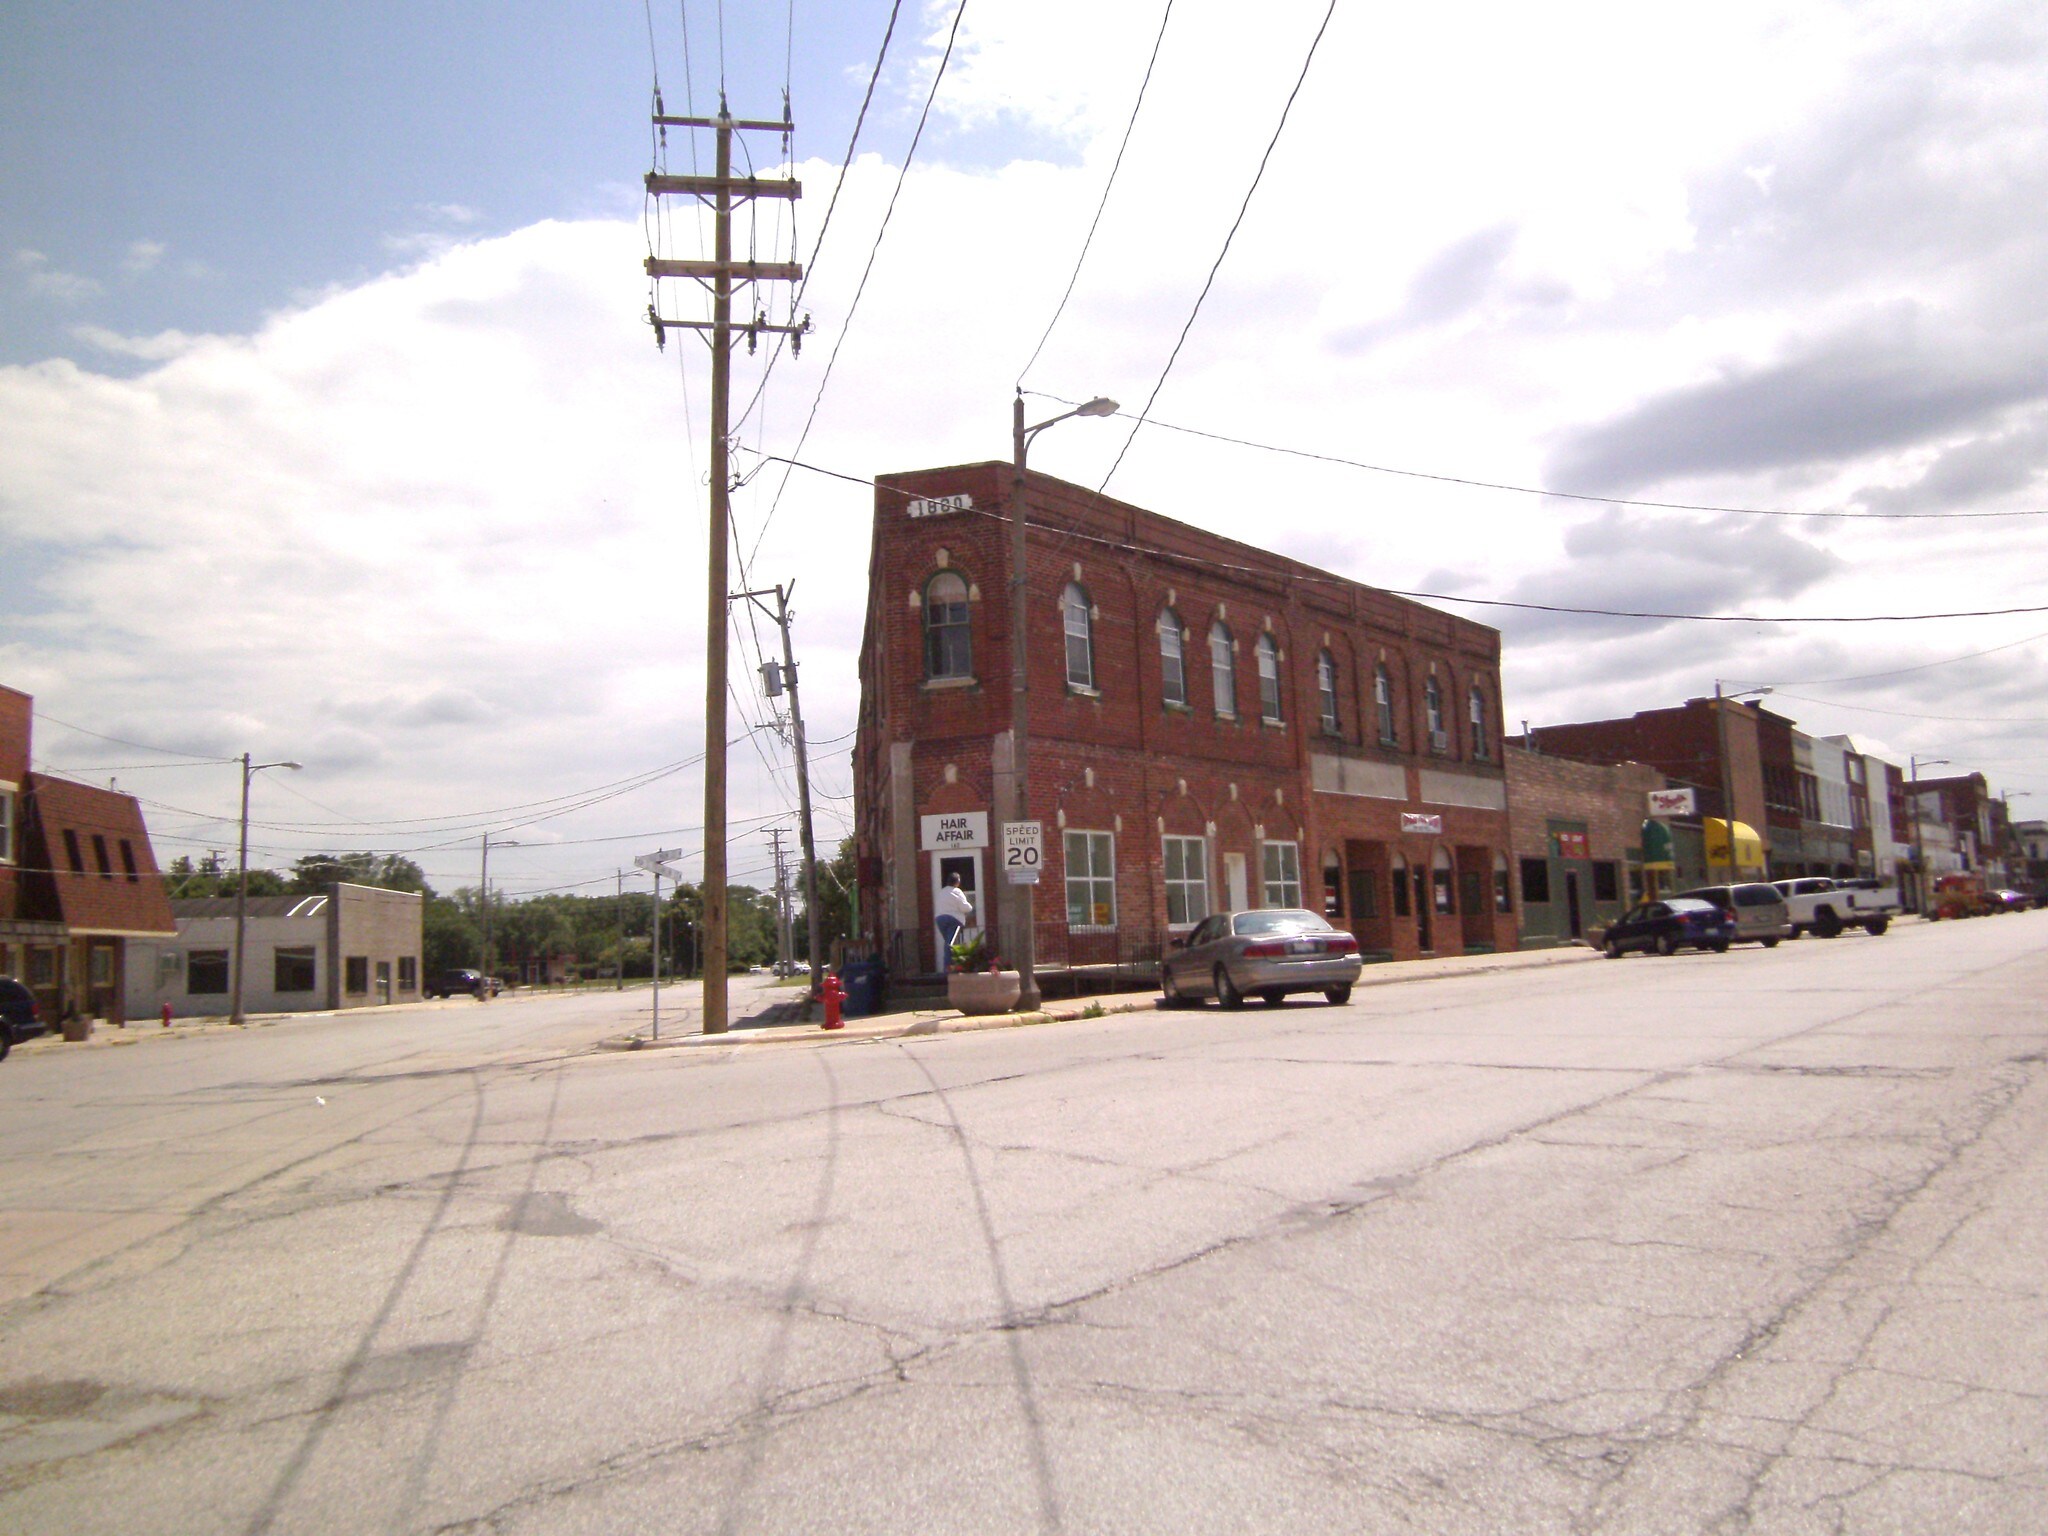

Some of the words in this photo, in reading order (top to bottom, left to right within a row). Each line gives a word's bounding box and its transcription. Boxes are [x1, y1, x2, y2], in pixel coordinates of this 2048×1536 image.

[940, 818, 967, 830] HAIR
[935, 829, 974, 842] AFFAIR
[1006, 826, 1039, 836] SPEED
[1009, 836, 1035, 846] LIMIT
[1007, 846, 1039, 866] 20
